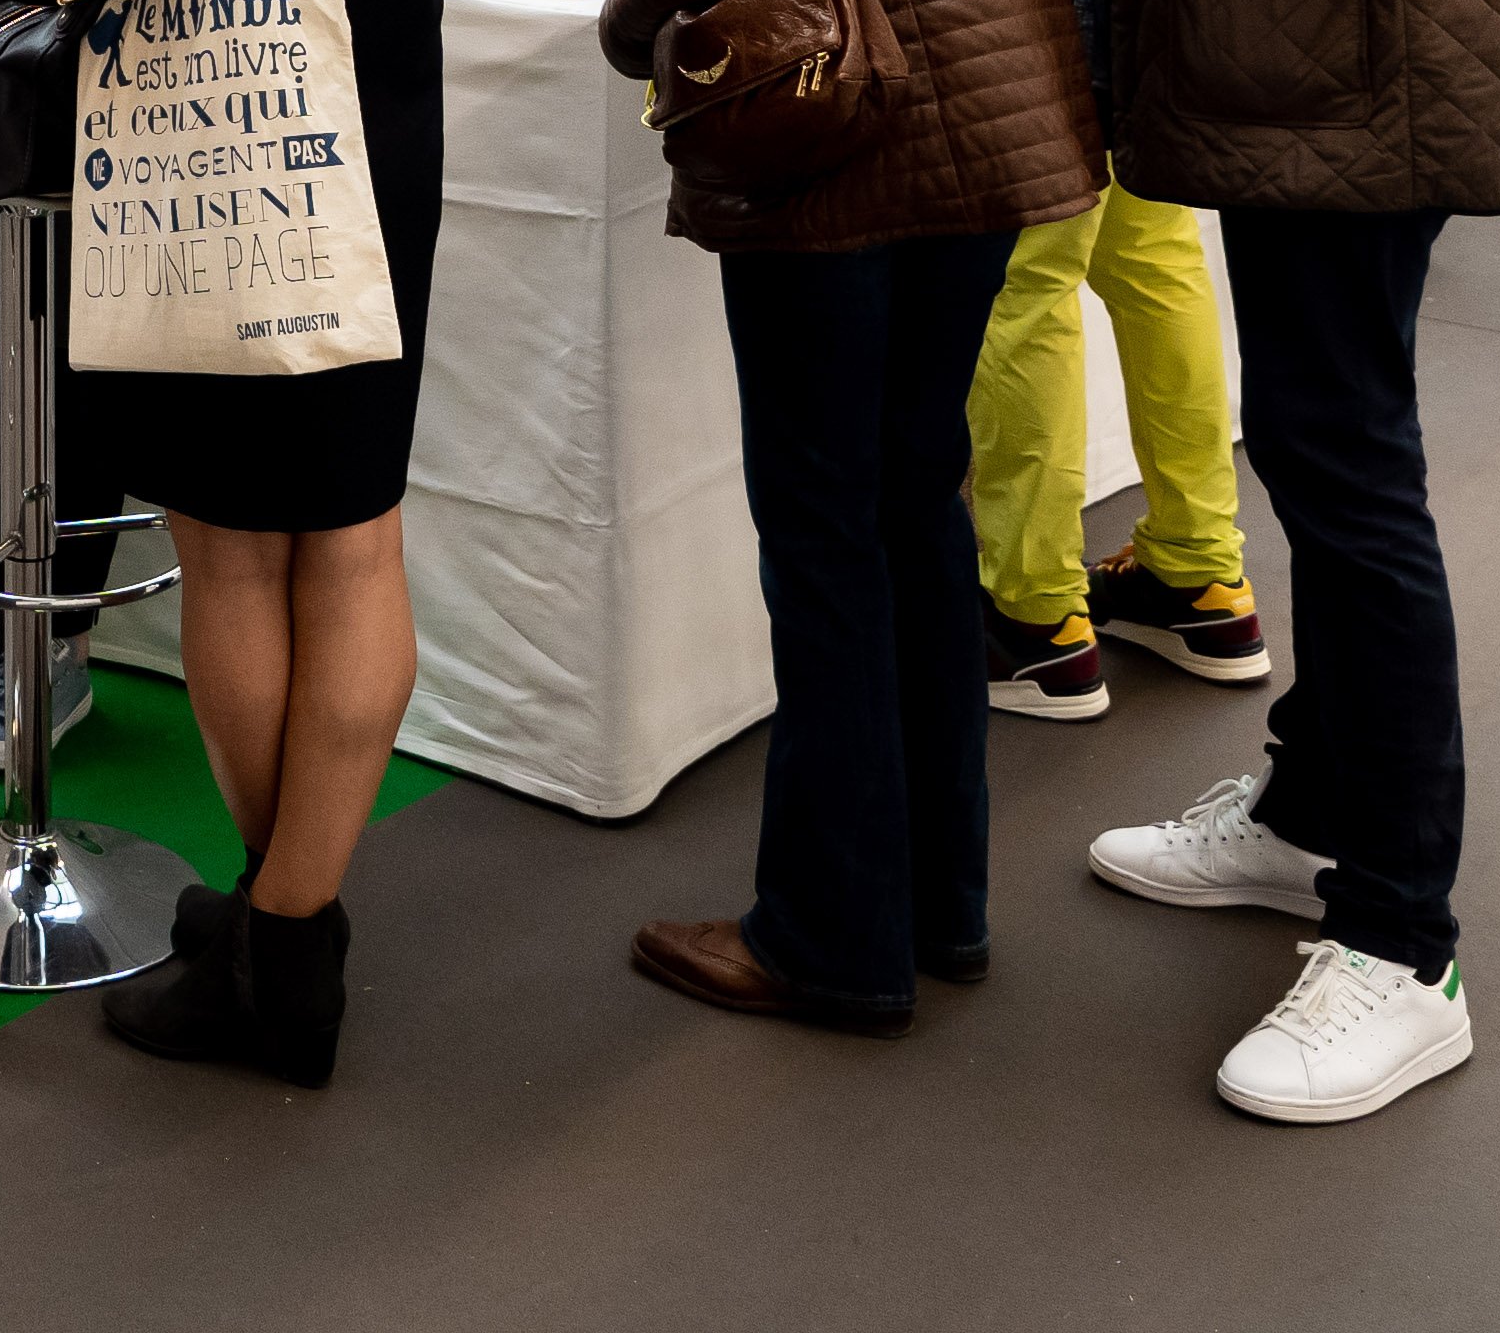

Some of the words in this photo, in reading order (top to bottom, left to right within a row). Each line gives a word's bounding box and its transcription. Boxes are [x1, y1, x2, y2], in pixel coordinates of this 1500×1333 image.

[136, 50, 178, 91] est
[184, 47, 218, 86] un
[224, 37, 308, 79] livre
[84, 100, 118, 141] et
[131, 96, 217, 135] ceux
[224, 75, 313, 134] qui
[92, 157, 106, 181] NE
[118, 141, 278, 184] VOYAGENT
[288, 139, 328, 166] PAS
[84, 239, 210, 299] QU'UNE
[224, 226, 335, 291] PAGE
[237, 318, 274, 342] SAINT
[277, 312, 340, 339] AUGUSTIN
